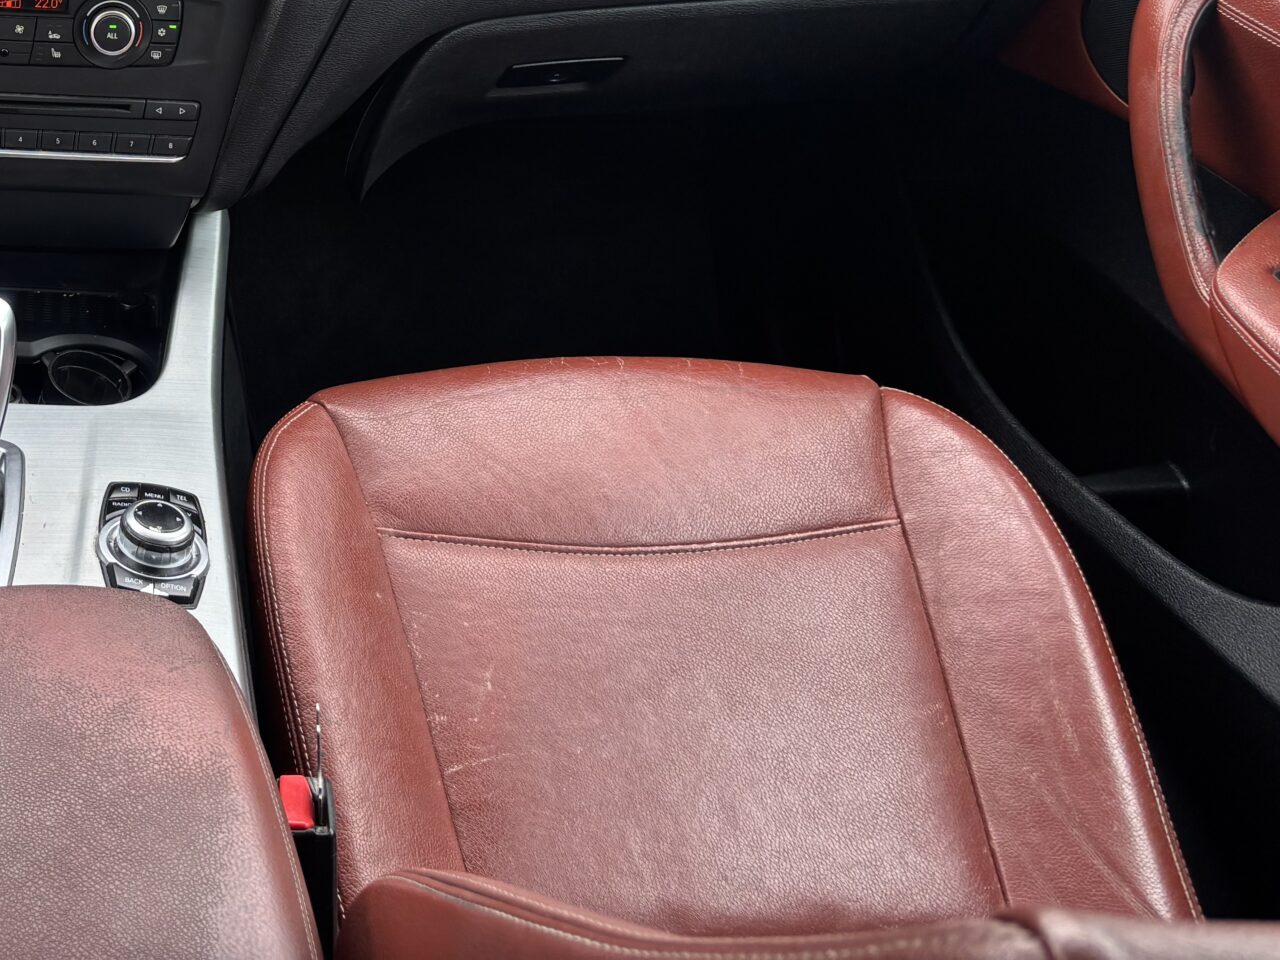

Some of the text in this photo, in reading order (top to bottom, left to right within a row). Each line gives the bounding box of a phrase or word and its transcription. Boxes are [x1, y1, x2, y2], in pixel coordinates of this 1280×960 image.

[106, 32, 118, 40] ALL
[144, 492, 164, 500] MENU
[176, 494, 188, 502] TEL
[124, 576, 144, 585] BACK
[160, 582, 187, 592] OPTION
